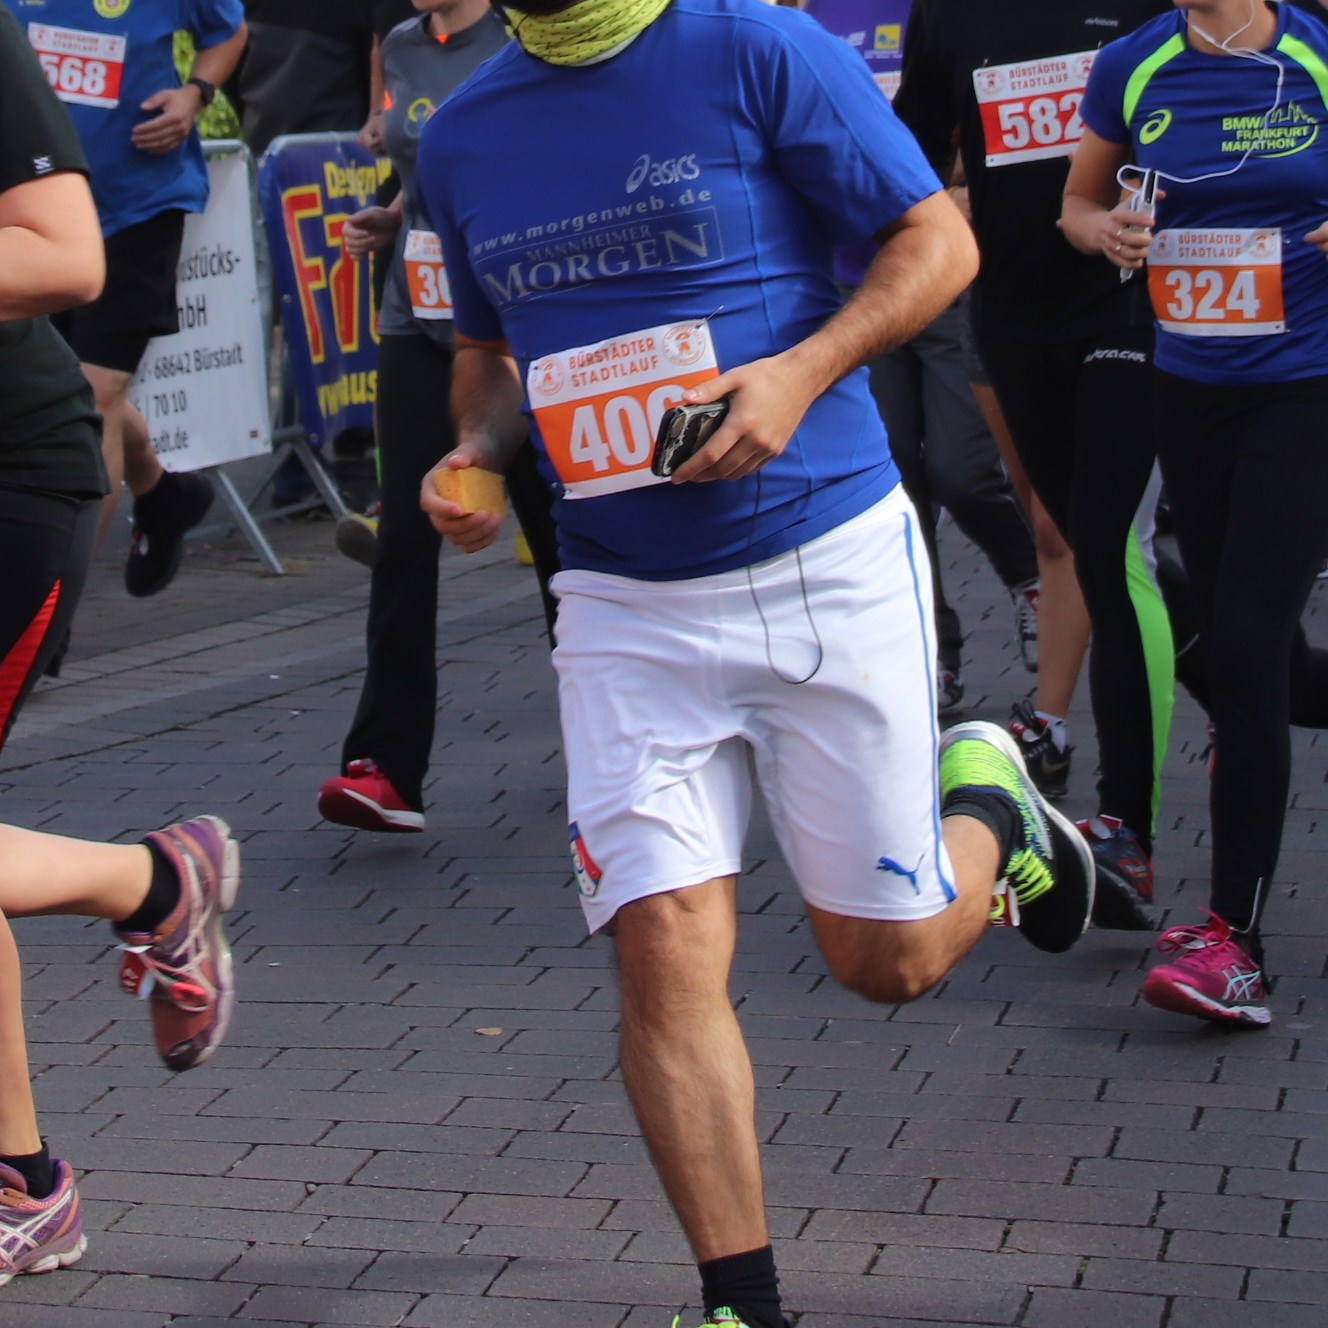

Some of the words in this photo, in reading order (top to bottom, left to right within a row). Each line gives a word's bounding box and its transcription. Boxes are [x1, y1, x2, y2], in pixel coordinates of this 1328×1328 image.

[39, 53, 108, 96] 568
[1009, 62, 1067, 80] BÜRSTÄDTER
[1010, 73, 1068, 92] STADTLAUF
[997, 92, 1087, 150] 582
[1223, 116, 1260, 131] BMW
[1236, 124, 1310, 140] FRANKFURT
[1222, 137, 1296, 152] MARATHON
[649, 153, 700, 187] asics
[527, 223, 652, 262] MANNHEIMER
[1178, 232, 1242, 245] BÜRSTÄDTER
[1178, 246, 1242, 259] STADTLAUF
[483, 222, 709, 306] MORGEN
[1165, 268, 1261, 320] 324
[569, 336, 657, 370] BÜRSTÄDTER
[571, 354, 660, 388] STADTLAUF
